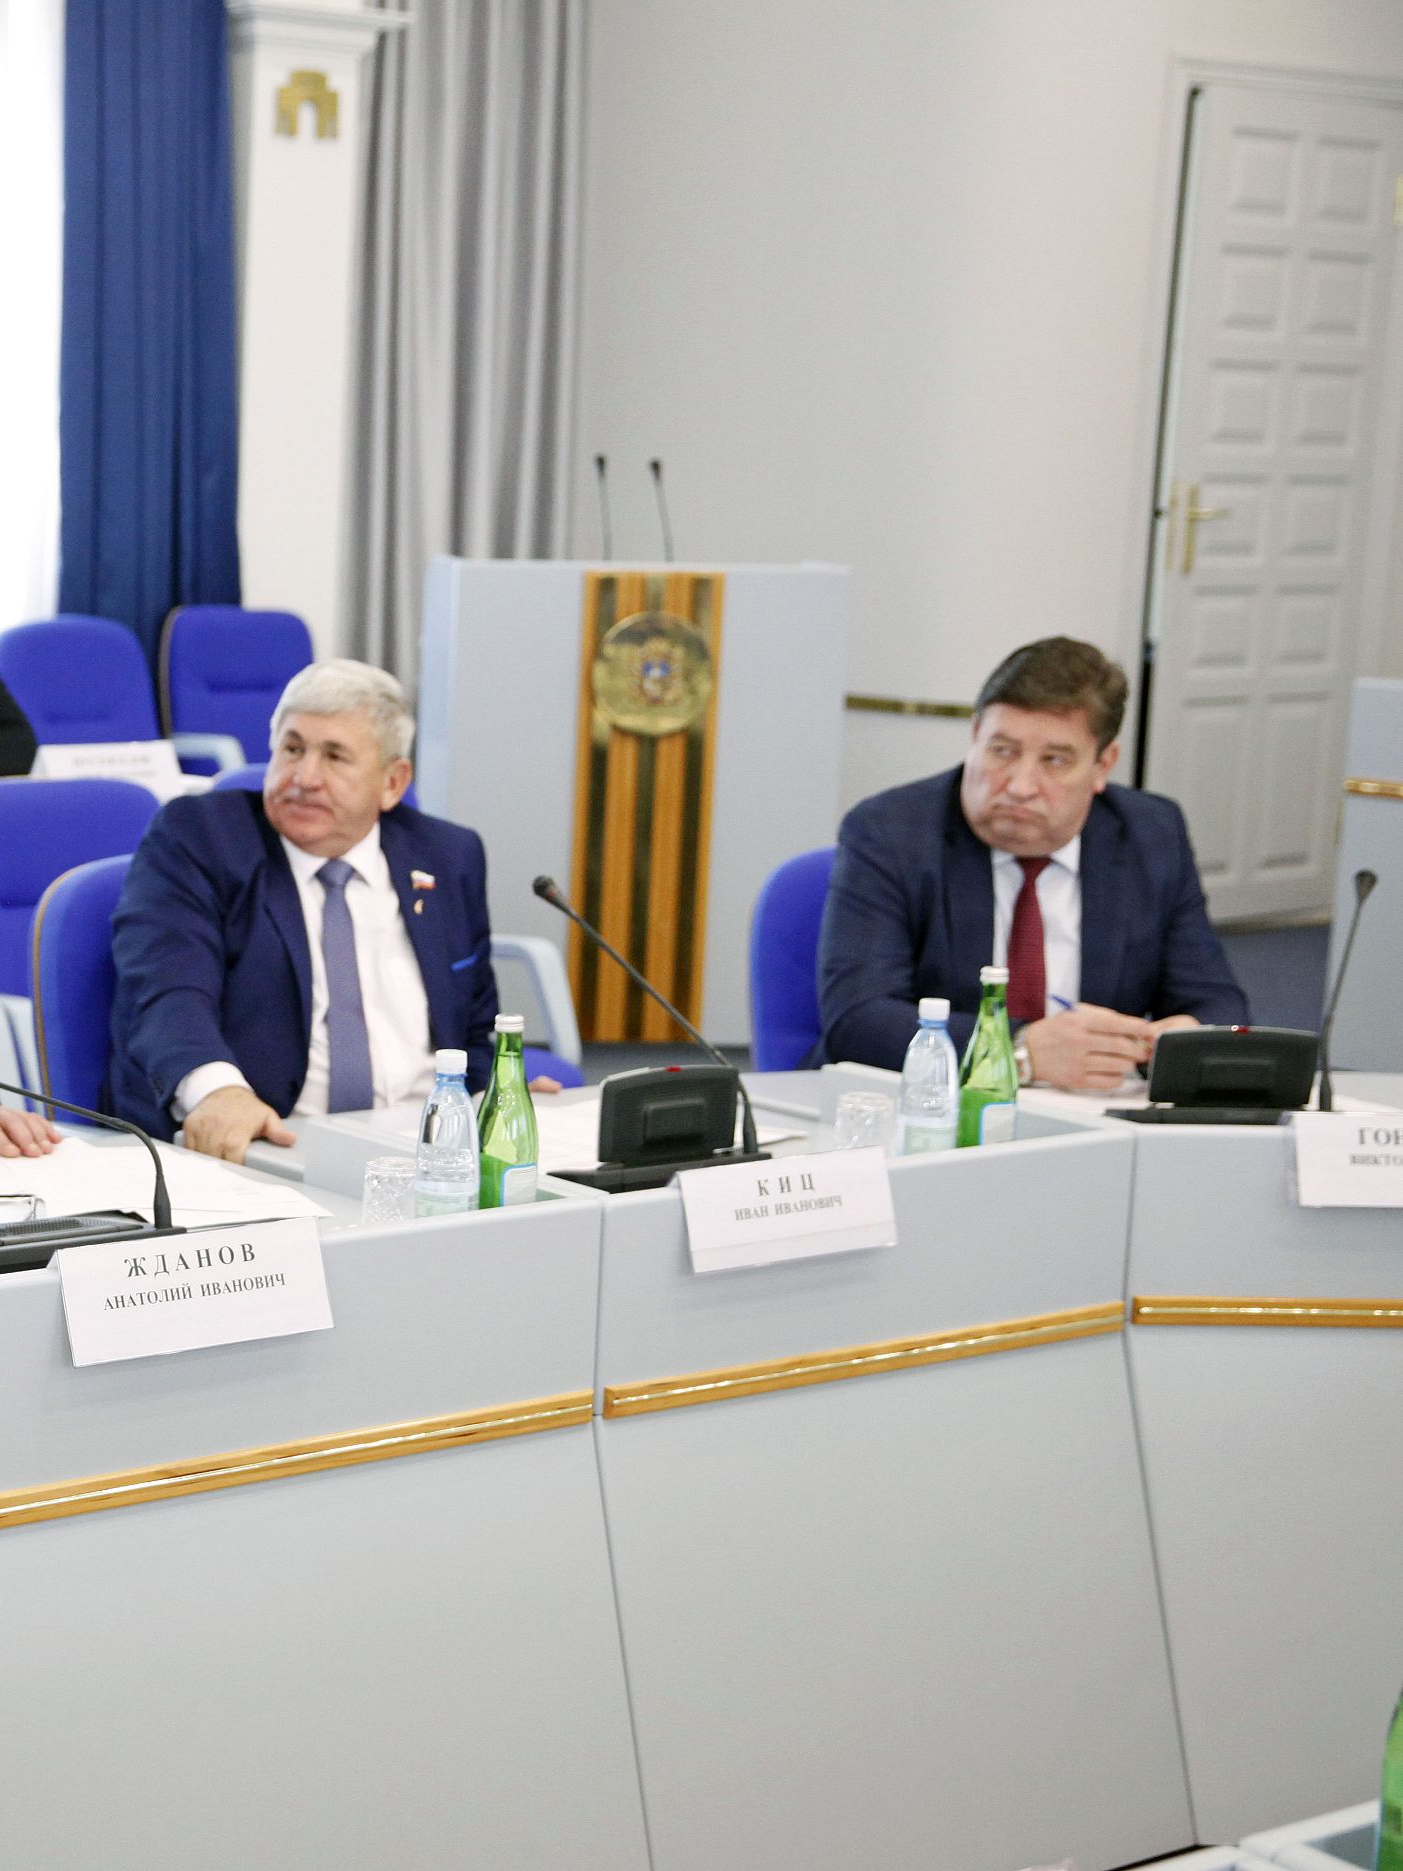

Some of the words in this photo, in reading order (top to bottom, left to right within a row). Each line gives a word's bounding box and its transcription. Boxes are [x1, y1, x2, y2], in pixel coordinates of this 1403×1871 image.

[757, 1173, 815, 1197] КИЦ
[734, 1206, 769, 1222] ИВАН
[774, 1195, 843, 1216] ИВАНОВИЧ
[123, 1243, 256, 1278] ЖДАНОВ
[103, 1282, 194, 1311] АНАТОЛИЙ
[200, 1272, 287, 1298] ИВАНОВИЧ
